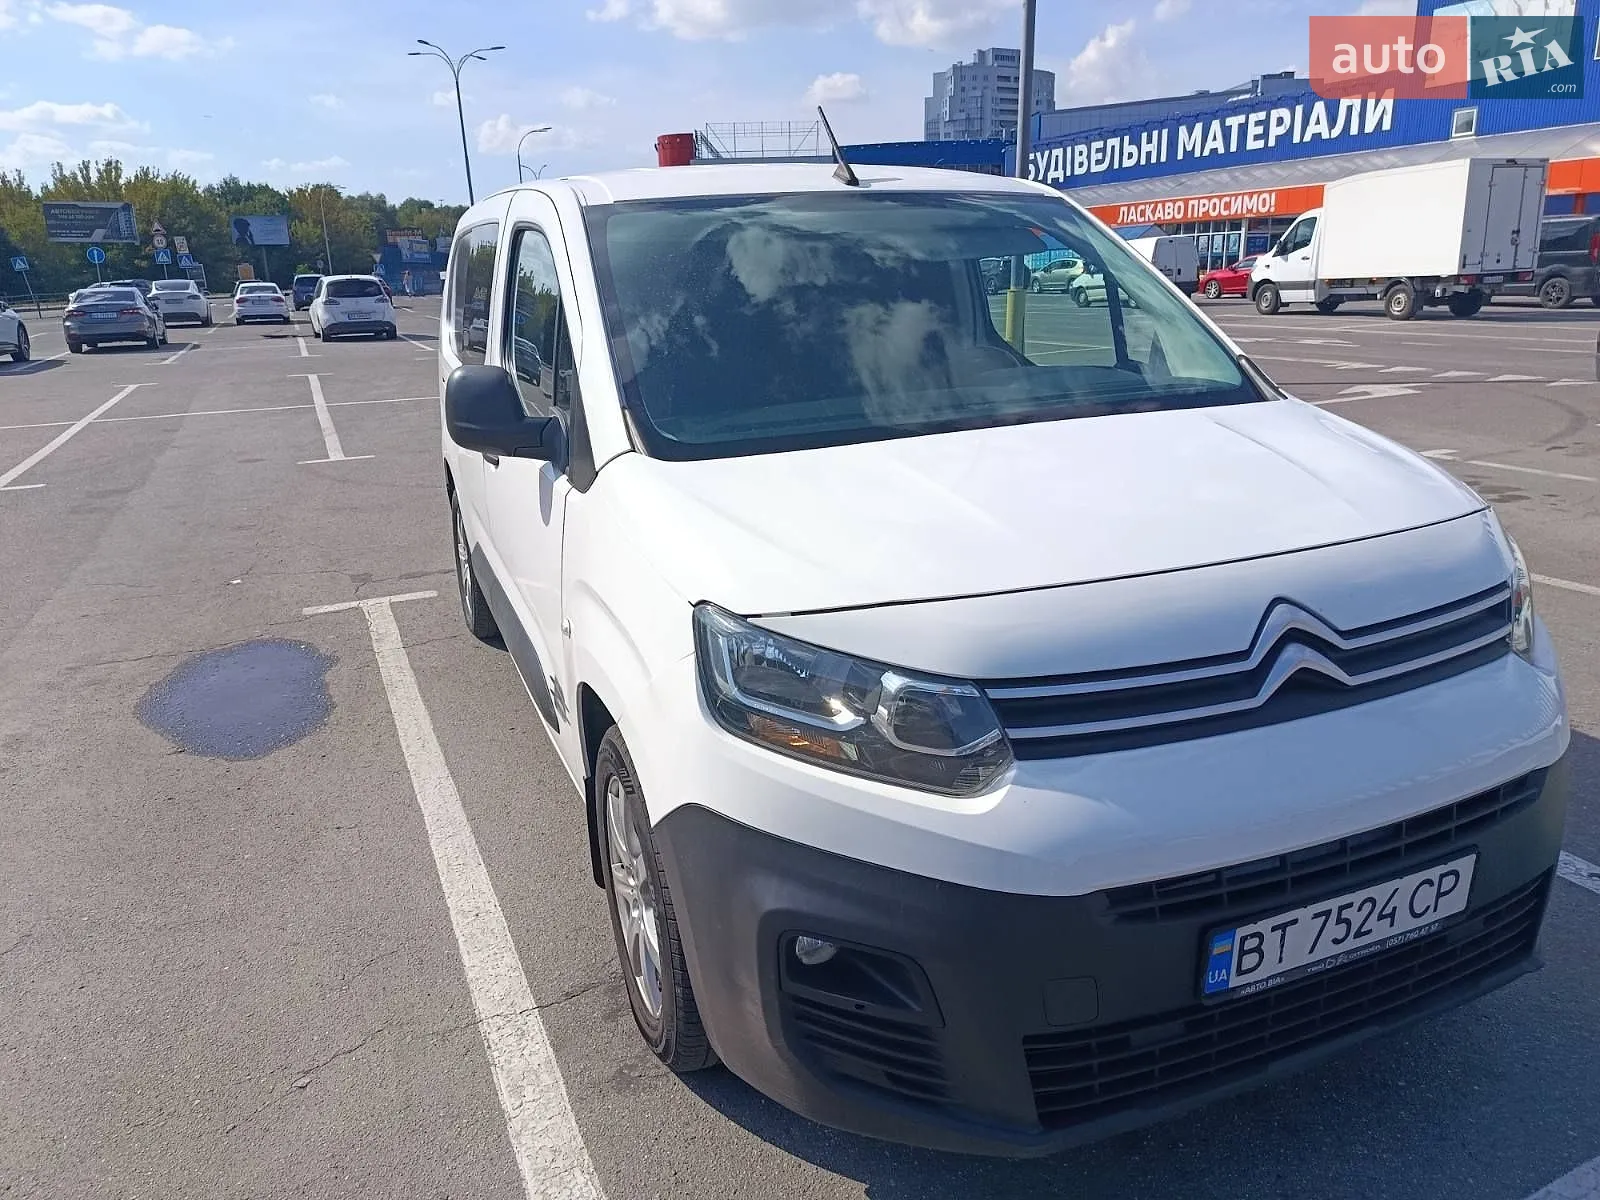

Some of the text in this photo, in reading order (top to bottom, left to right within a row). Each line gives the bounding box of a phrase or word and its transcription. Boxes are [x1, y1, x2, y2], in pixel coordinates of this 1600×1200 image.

[1177, 88, 1394, 160] МАТЕРІАЛИ
[1117, 192, 1276, 224] ЛАСКАВО ПРОСИМО!
[1235, 869, 1460, 977] BT 7524 CP
[1208, 969, 1228, 984] UA
